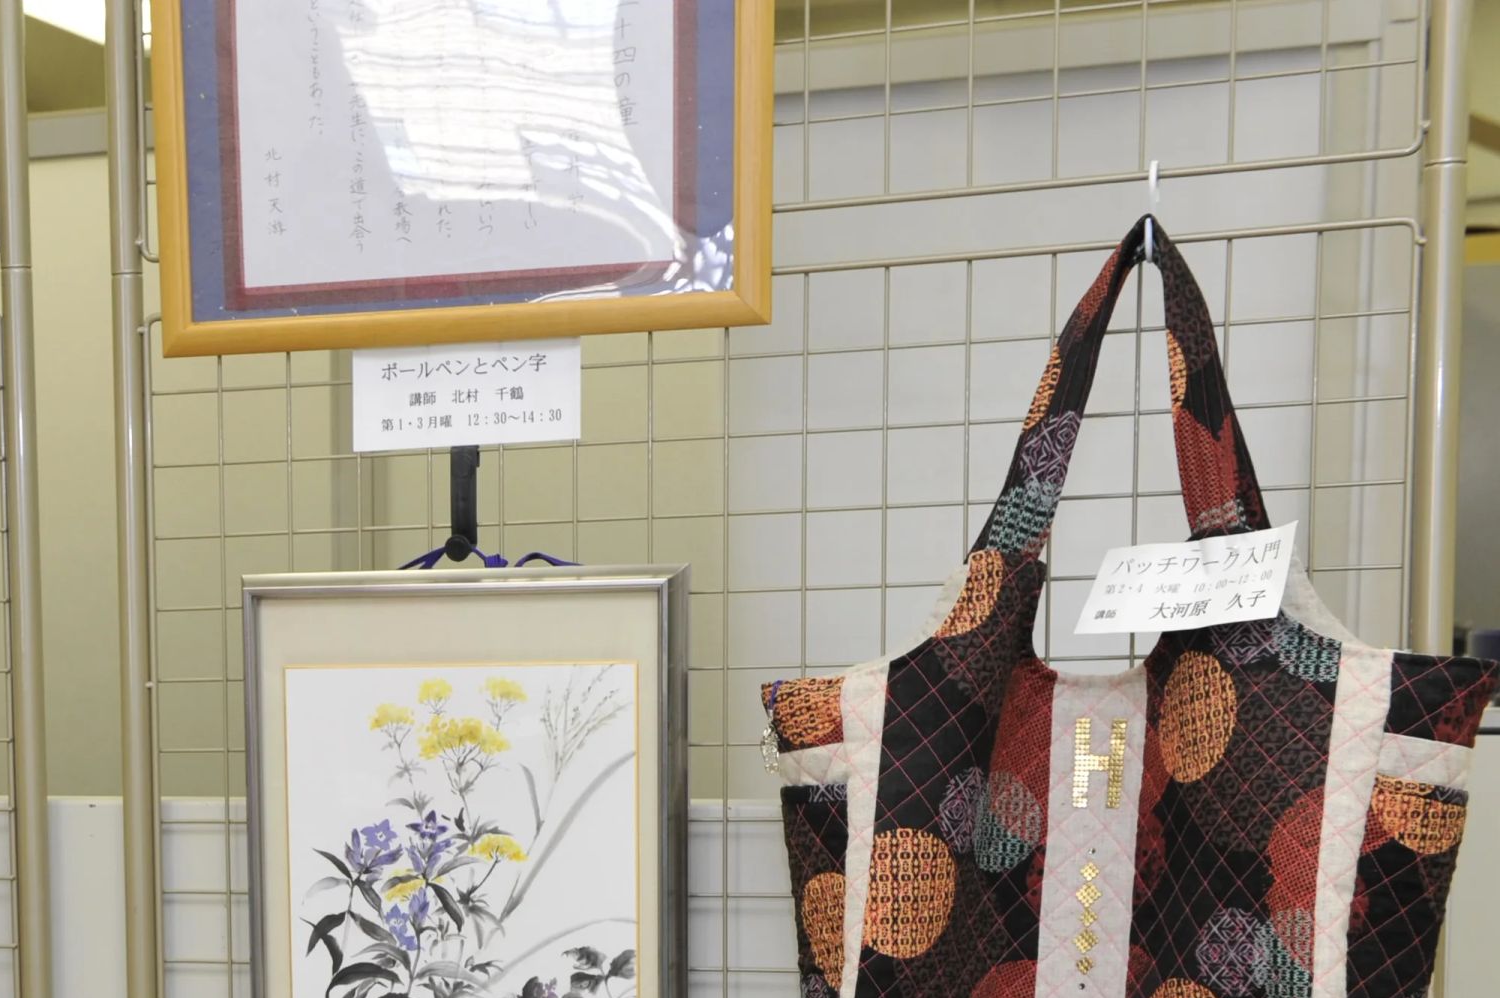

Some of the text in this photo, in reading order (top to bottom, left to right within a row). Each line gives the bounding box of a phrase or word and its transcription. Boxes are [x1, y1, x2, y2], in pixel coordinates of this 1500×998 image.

[381, 353, 547, 381] ボールペンとペン字
[409, 386, 524, 406] 講師 北村 千鶴
[1111, 539, 1281, 575] パッチワーク入門
[1094, 589, 1266, 620] 講師 大河原 久子
[1072, 716, 1128, 810] H
